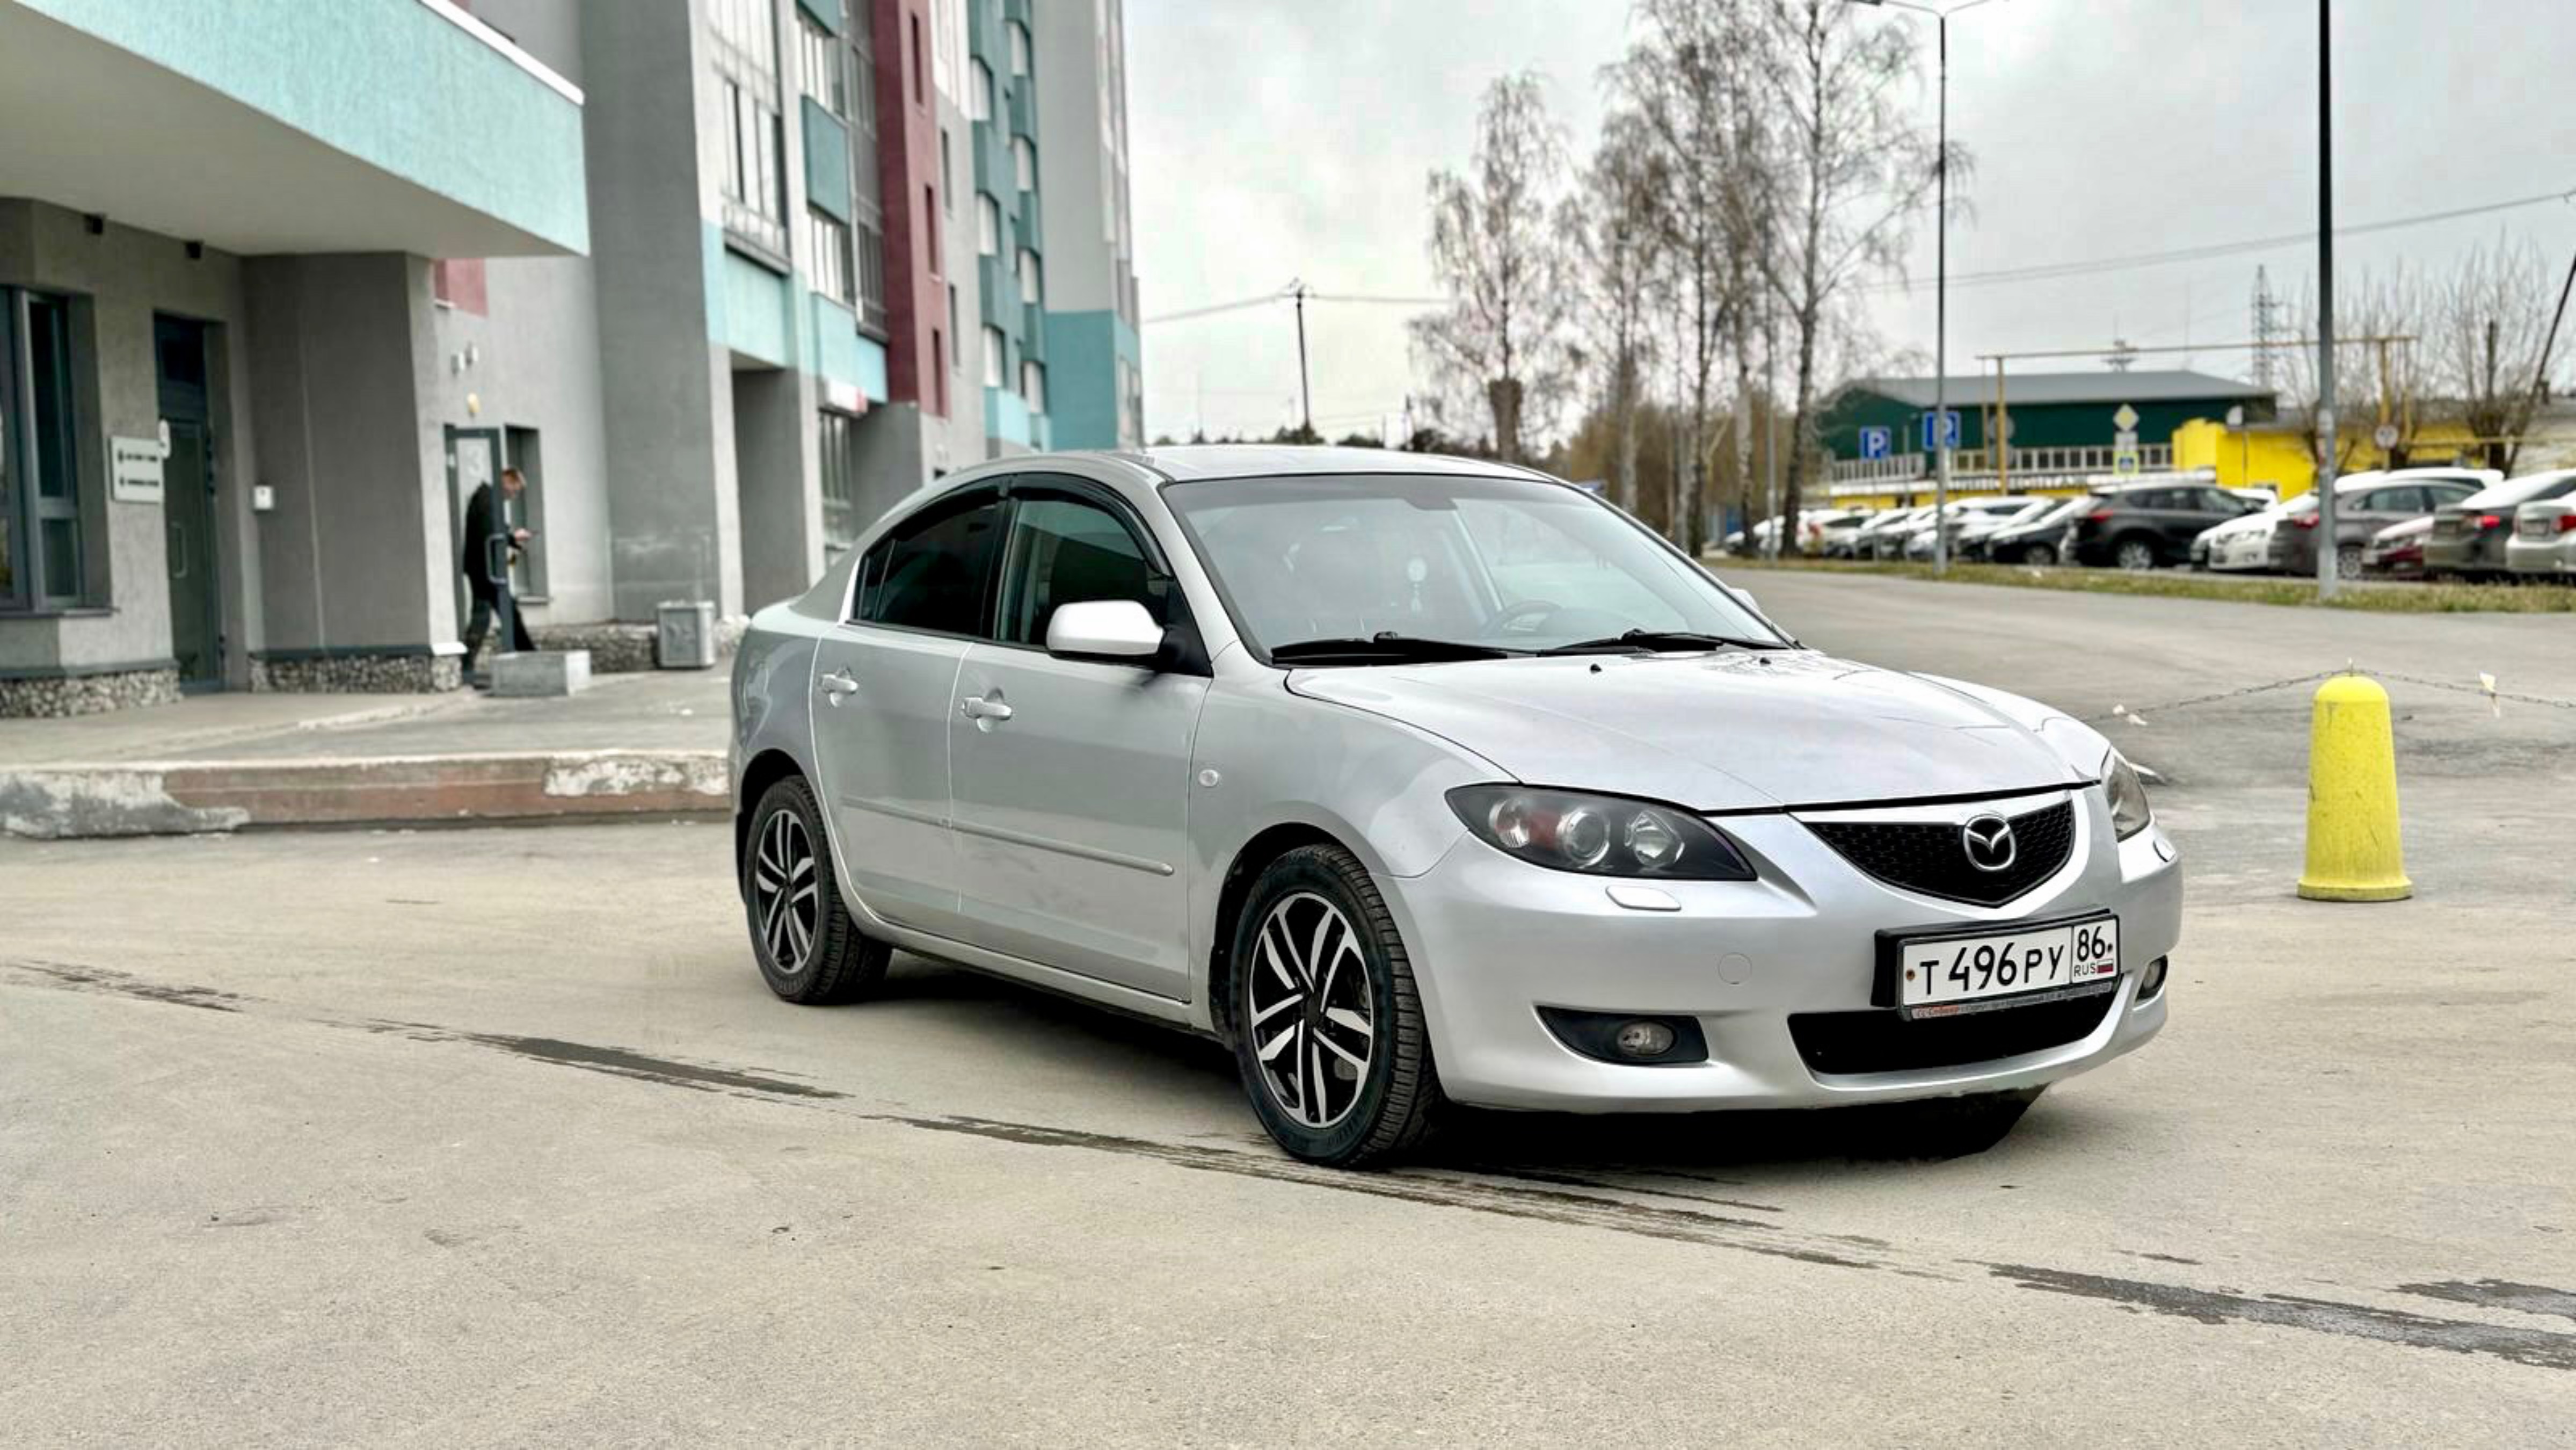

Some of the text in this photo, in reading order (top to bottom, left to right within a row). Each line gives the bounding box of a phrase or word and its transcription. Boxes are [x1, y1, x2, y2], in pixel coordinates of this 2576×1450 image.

[1868, 431, 1886, 459] P
[2077, 925, 2106, 962] 86
[2074, 962, 2096, 977] RUS
